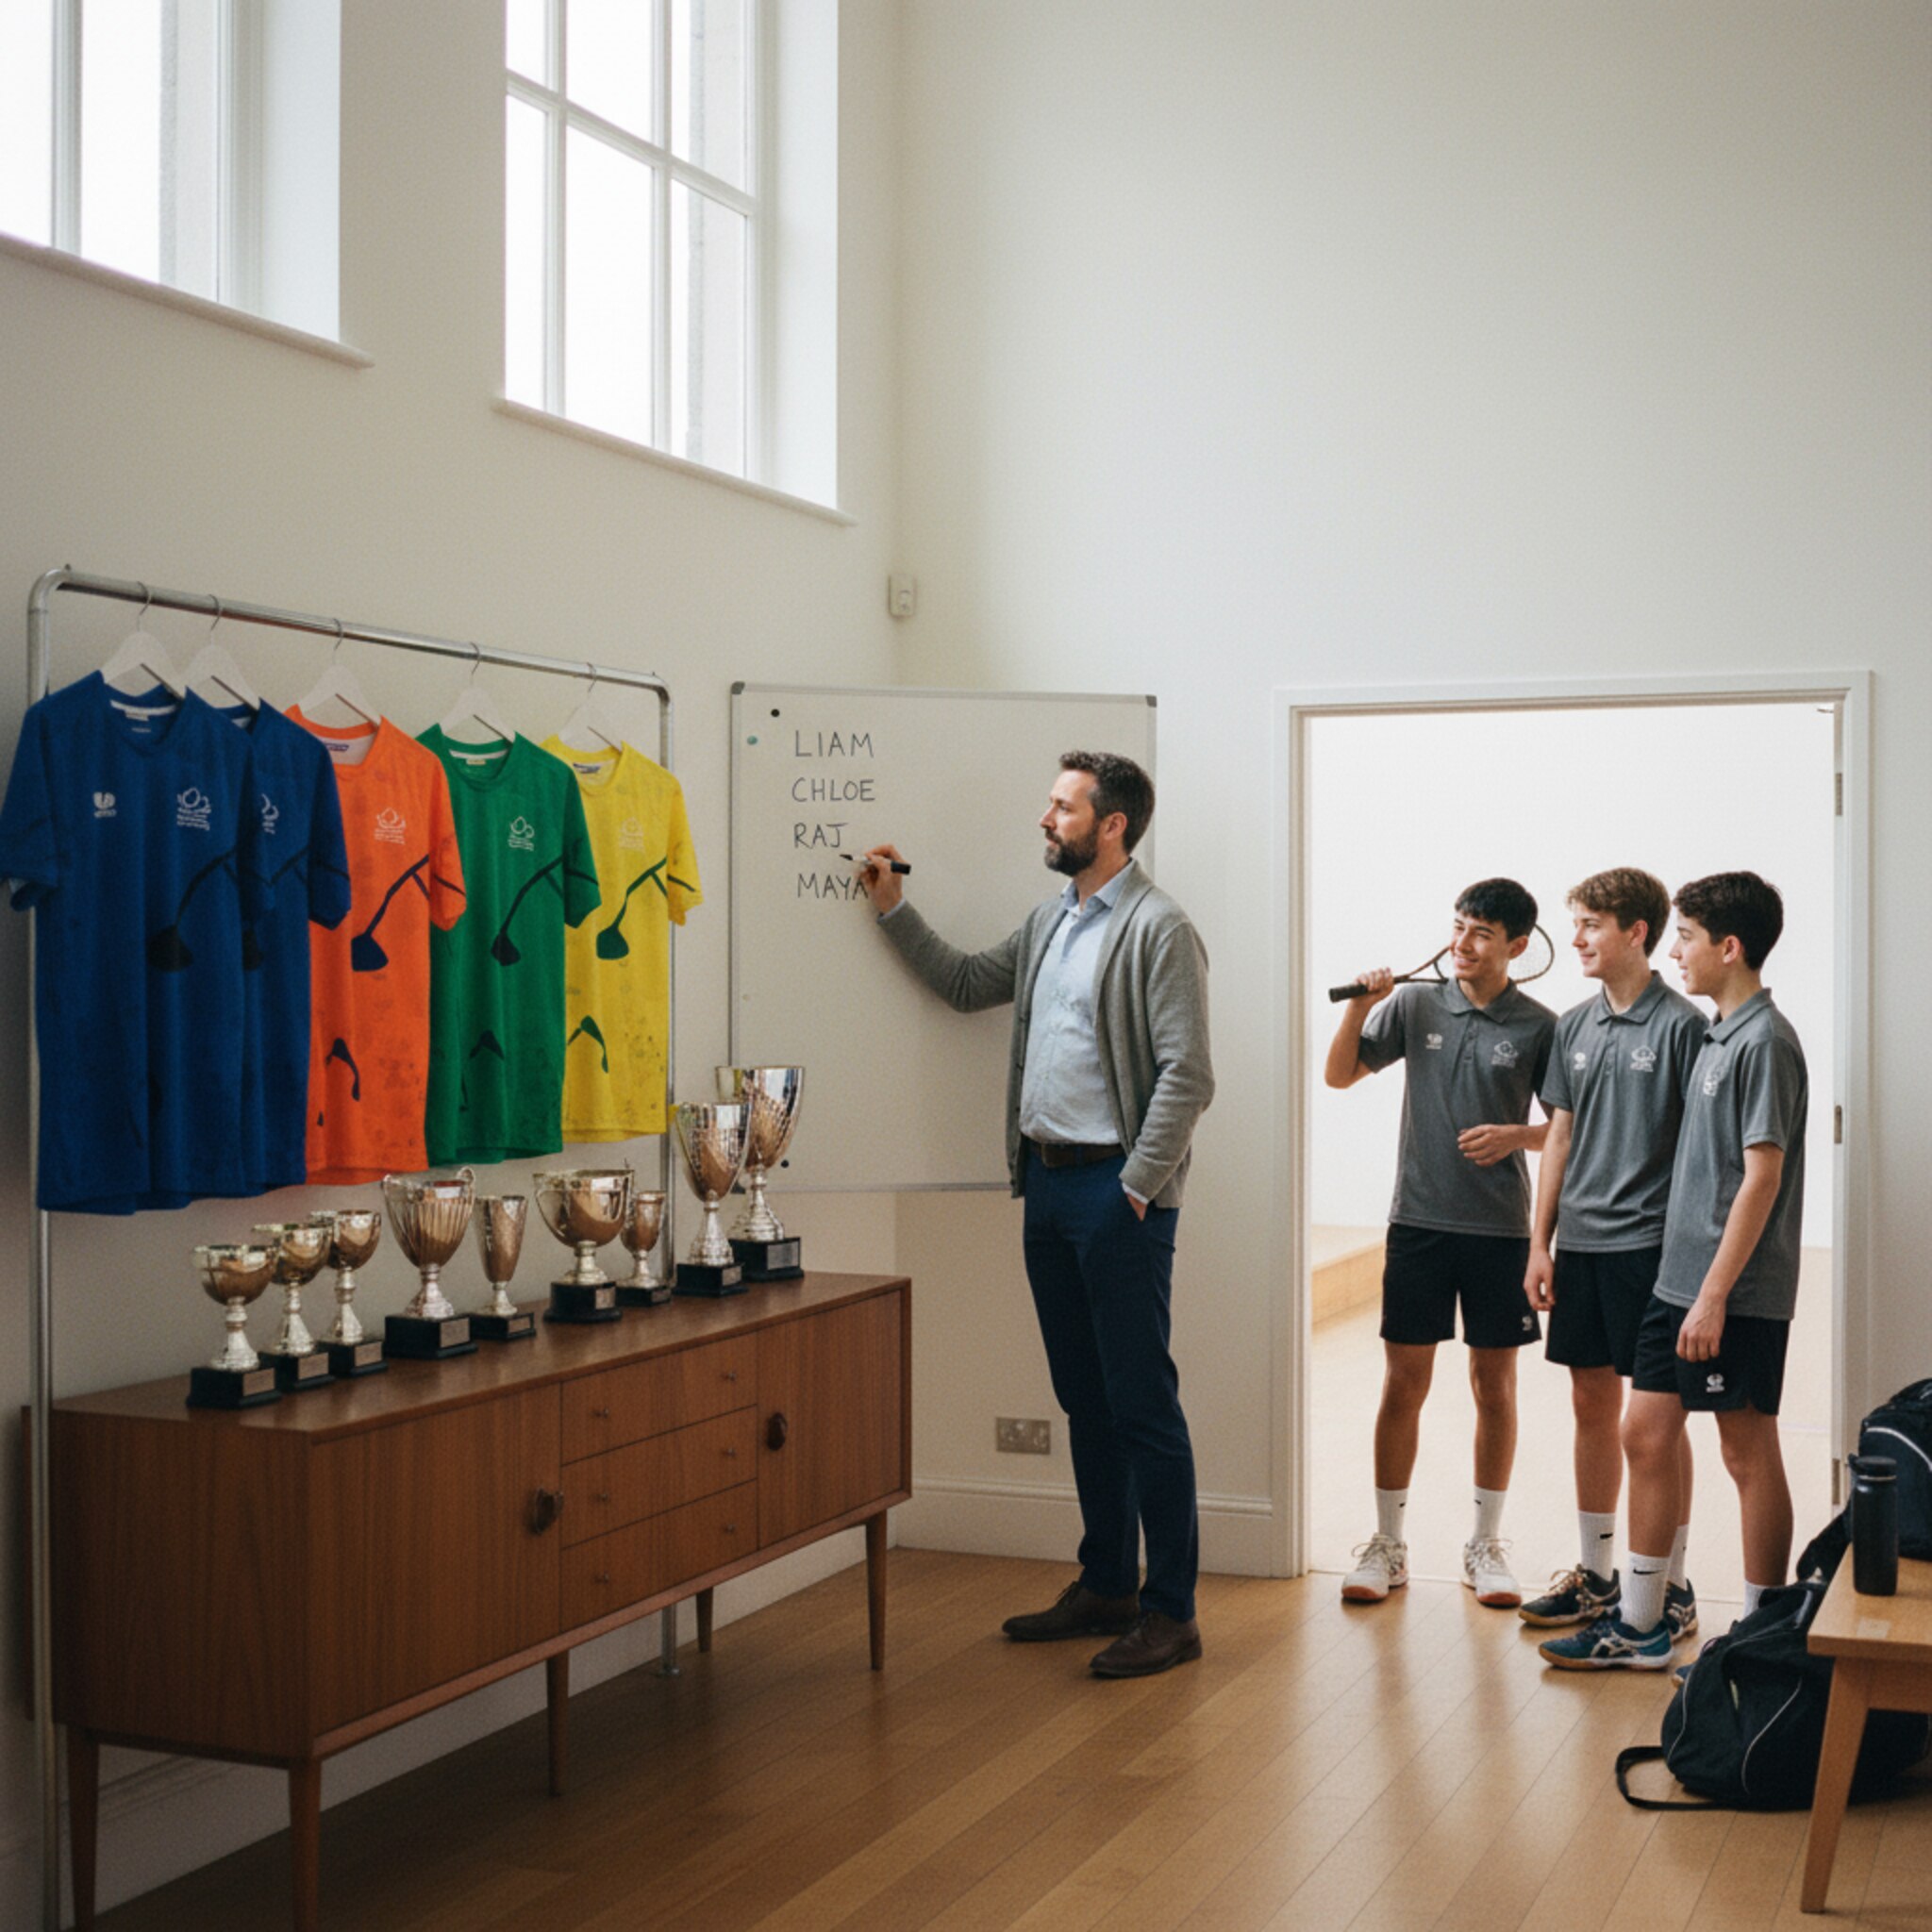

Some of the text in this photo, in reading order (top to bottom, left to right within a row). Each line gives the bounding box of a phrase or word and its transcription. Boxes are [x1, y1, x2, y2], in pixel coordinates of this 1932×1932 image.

[795, 730, 874, 758] LIAM
[791, 777, 875, 802] CHLOE
[793, 823, 848, 849] RAJ
[797, 873, 869, 901] MAYA
